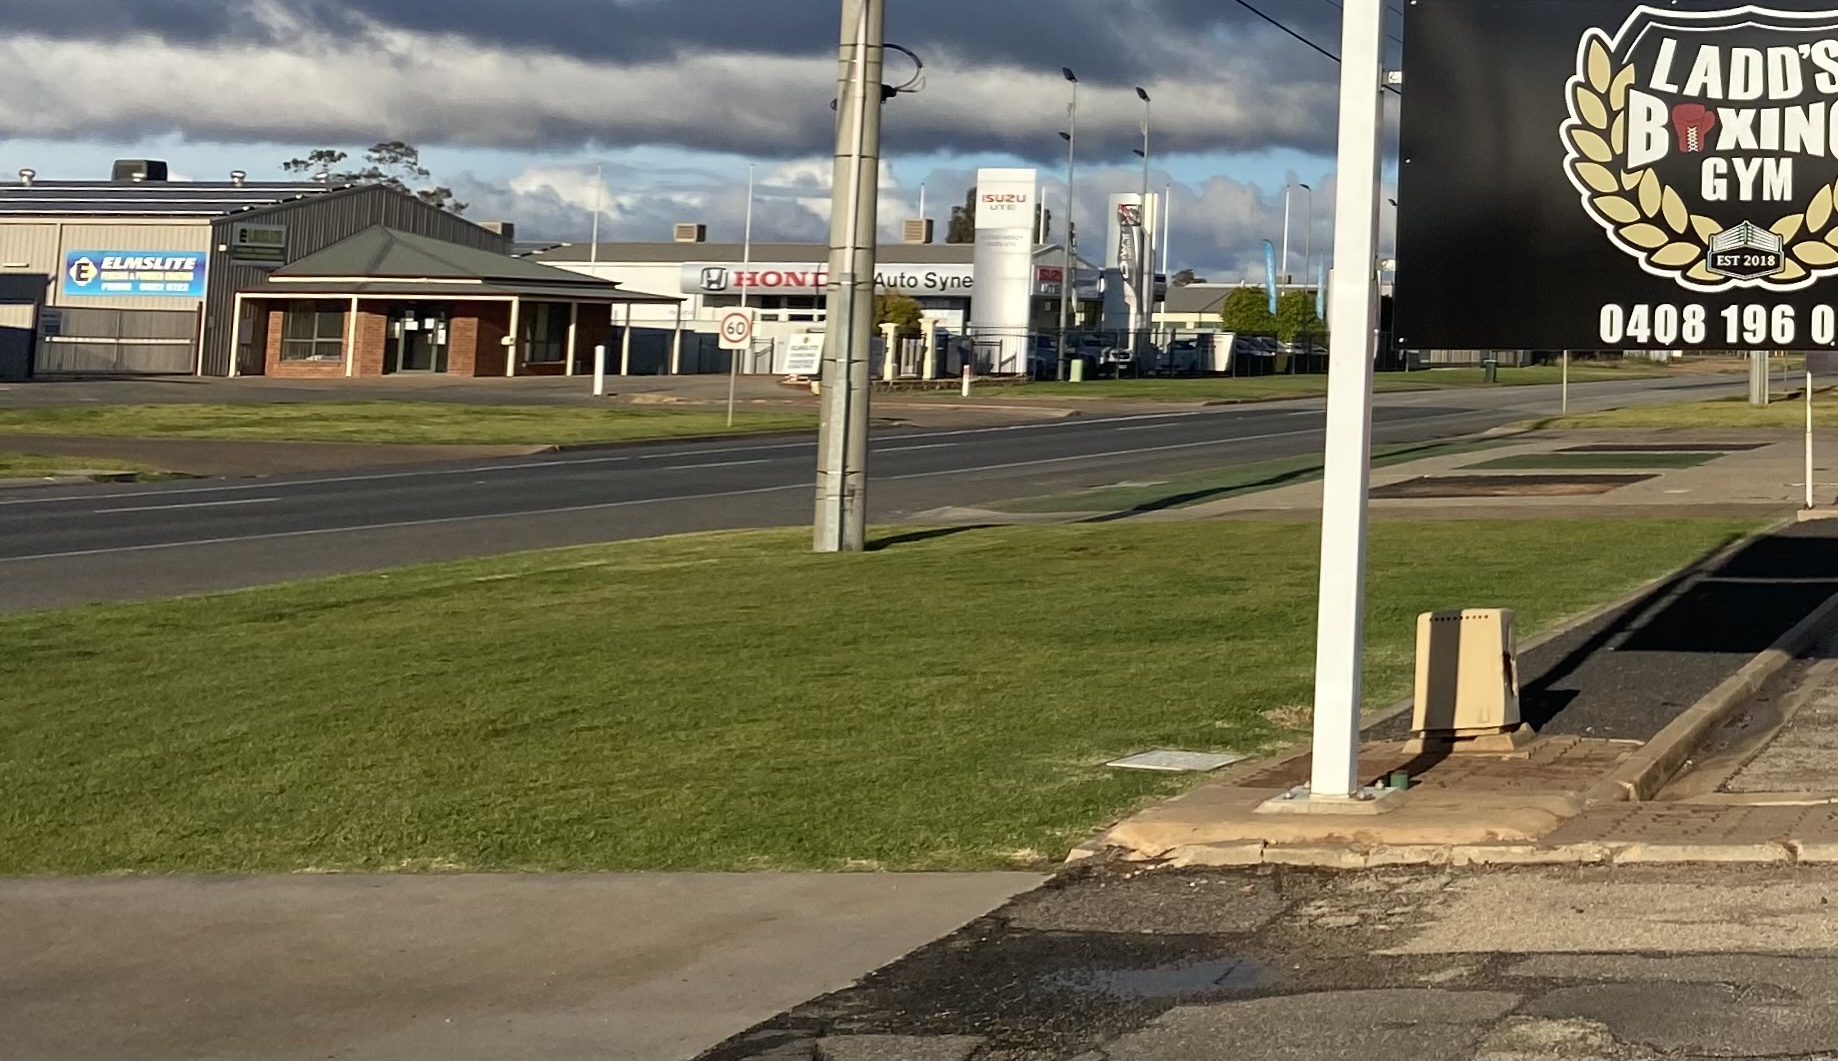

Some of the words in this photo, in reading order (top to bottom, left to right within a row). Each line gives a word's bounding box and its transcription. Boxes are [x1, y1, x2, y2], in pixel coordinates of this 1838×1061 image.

[1700, 156, 1793, 202] GYM
[981, 194, 1027, 203] ISUZU
[101, 256, 198, 270] ELMSLITE
[1716, 255, 1741, 267] EST
[1743, 255, 1776, 267] 2018
[733, 271, 829, 288] HOND
[874, 272, 919, 288] Auto
[924, 271, 974, 292] Syne
[726, 321, 746, 336] 60
[1598, 304, 1706, 344] 0408
[1721, 304, 1796, 344] 196
